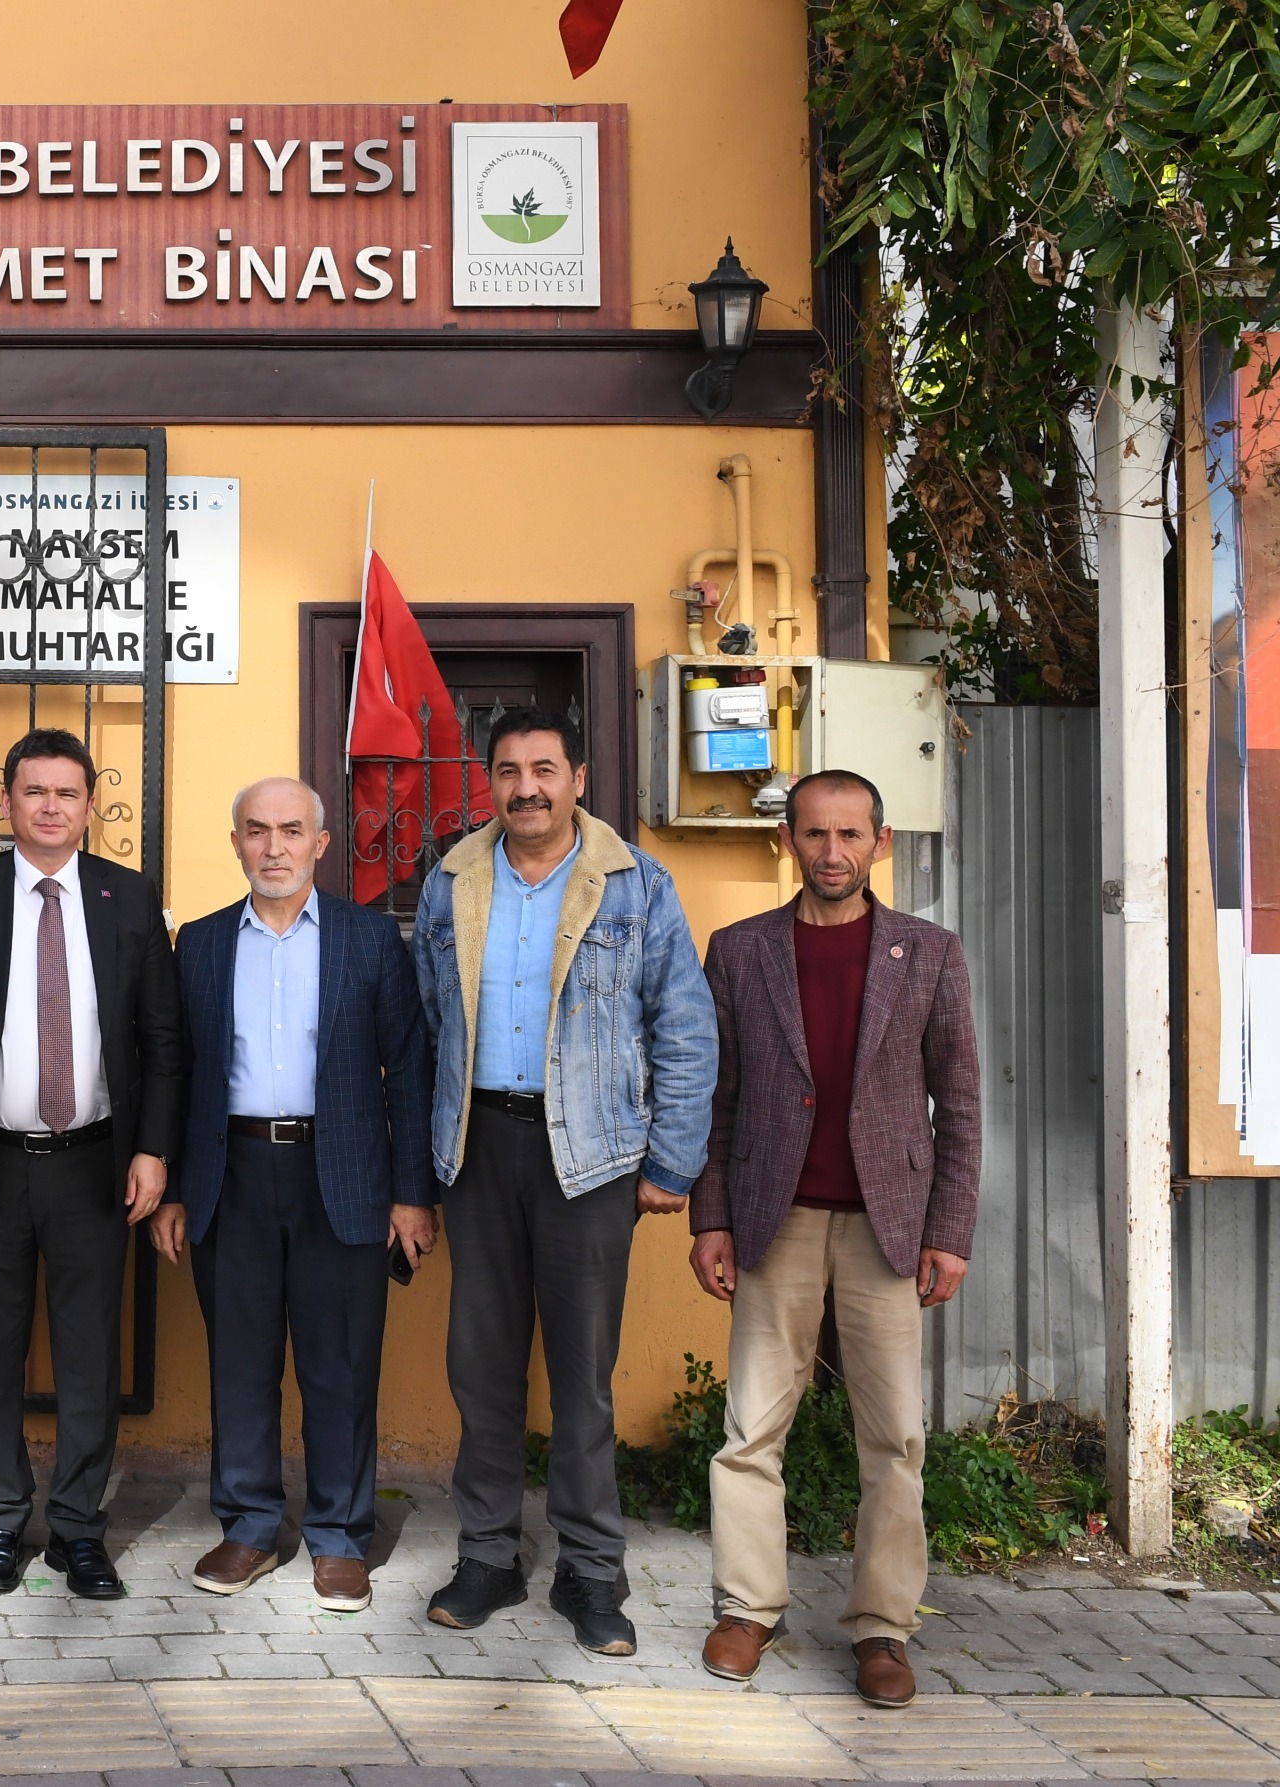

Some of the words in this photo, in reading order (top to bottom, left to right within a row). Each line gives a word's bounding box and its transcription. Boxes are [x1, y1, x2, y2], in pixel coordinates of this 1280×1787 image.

[476, 180, 486, 210] BURSA
[481, 147, 531, 179] OSMANGAZİ
[531, 149, 574, 190] BELEDİYESİ
[565, 191, 573, 210] 1987
[165, 228, 417, 303] BİNASI
[467, 259, 585, 277] OSMANGAZİ
[469, 278, 585, 293] BELEDİYESİ
[131, 490, 198, 511] İLESİ
[0, 580, 188, 611] MAHALE
